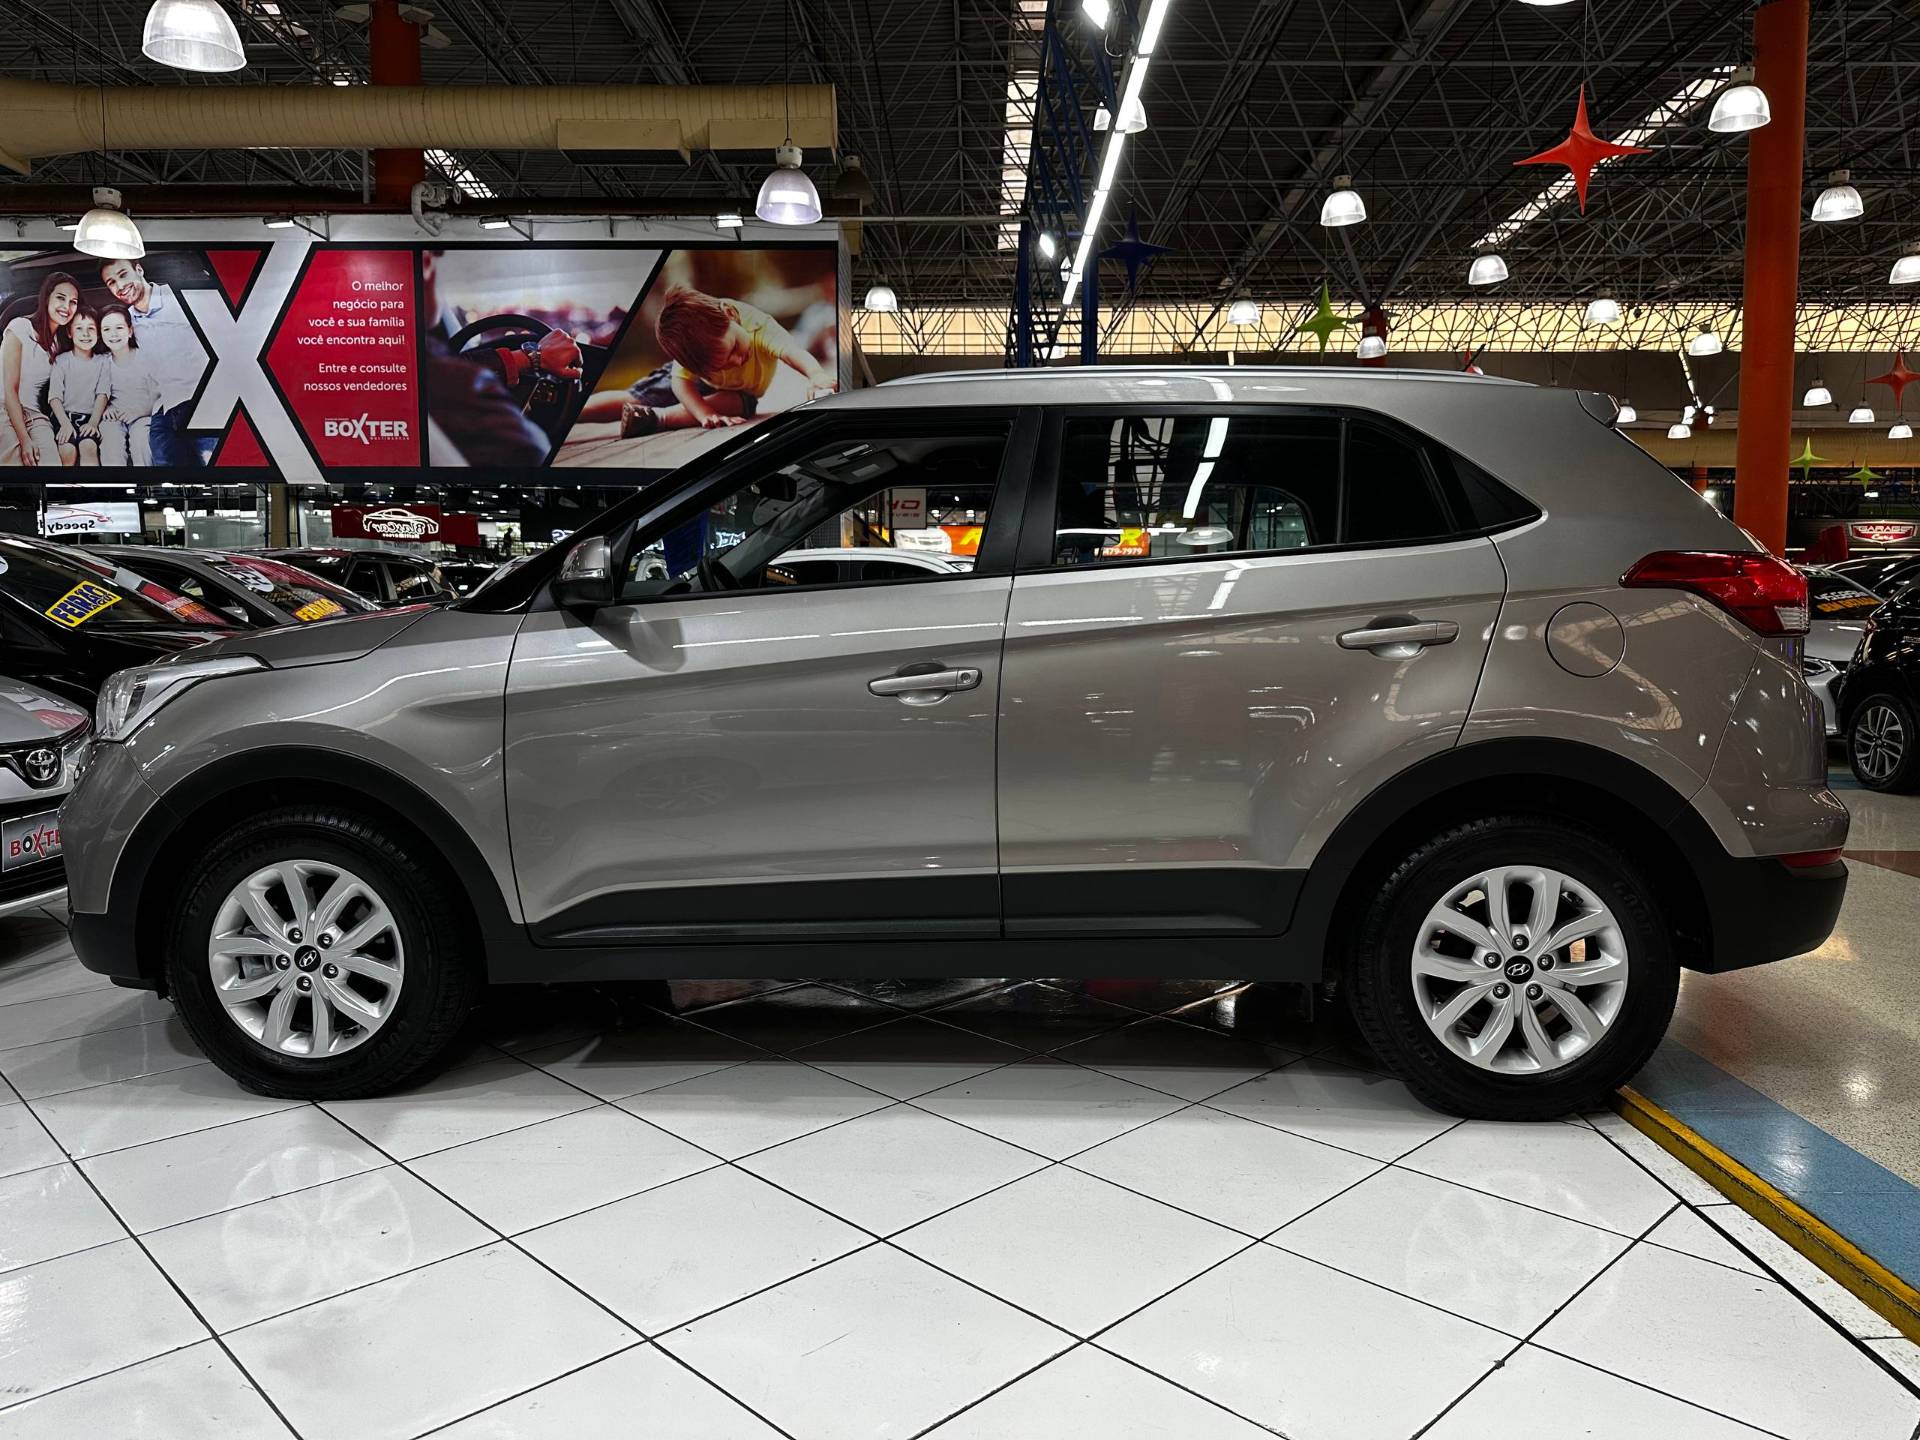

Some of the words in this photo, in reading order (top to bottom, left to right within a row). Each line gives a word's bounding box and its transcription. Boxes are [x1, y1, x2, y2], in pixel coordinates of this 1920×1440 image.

[352, 281, 361, 291] O
[364, 281, 404, 291] melhor
[333, 299, 377, 311] negócio
[380, 301, 404, 311] para
[309, 317, 335, 327] você
[338, 319, 345, 327] e
[347, 319, 366, 327] sua
[369, 317, 405, 327] família
[297, 335, 324, 345] você
[327, 335, 376, 345] encontra
[378, 335, 405, 347] aqui!
[319, 363, 347, 373] Entre
[350, 365, 357, 373] e
[360, 363, 407, 373] consulte
[304, 382, 341, 391] nossos
[344, 381, 407, 391] vendedores
[324, 413, 409, 445] BOXTER
